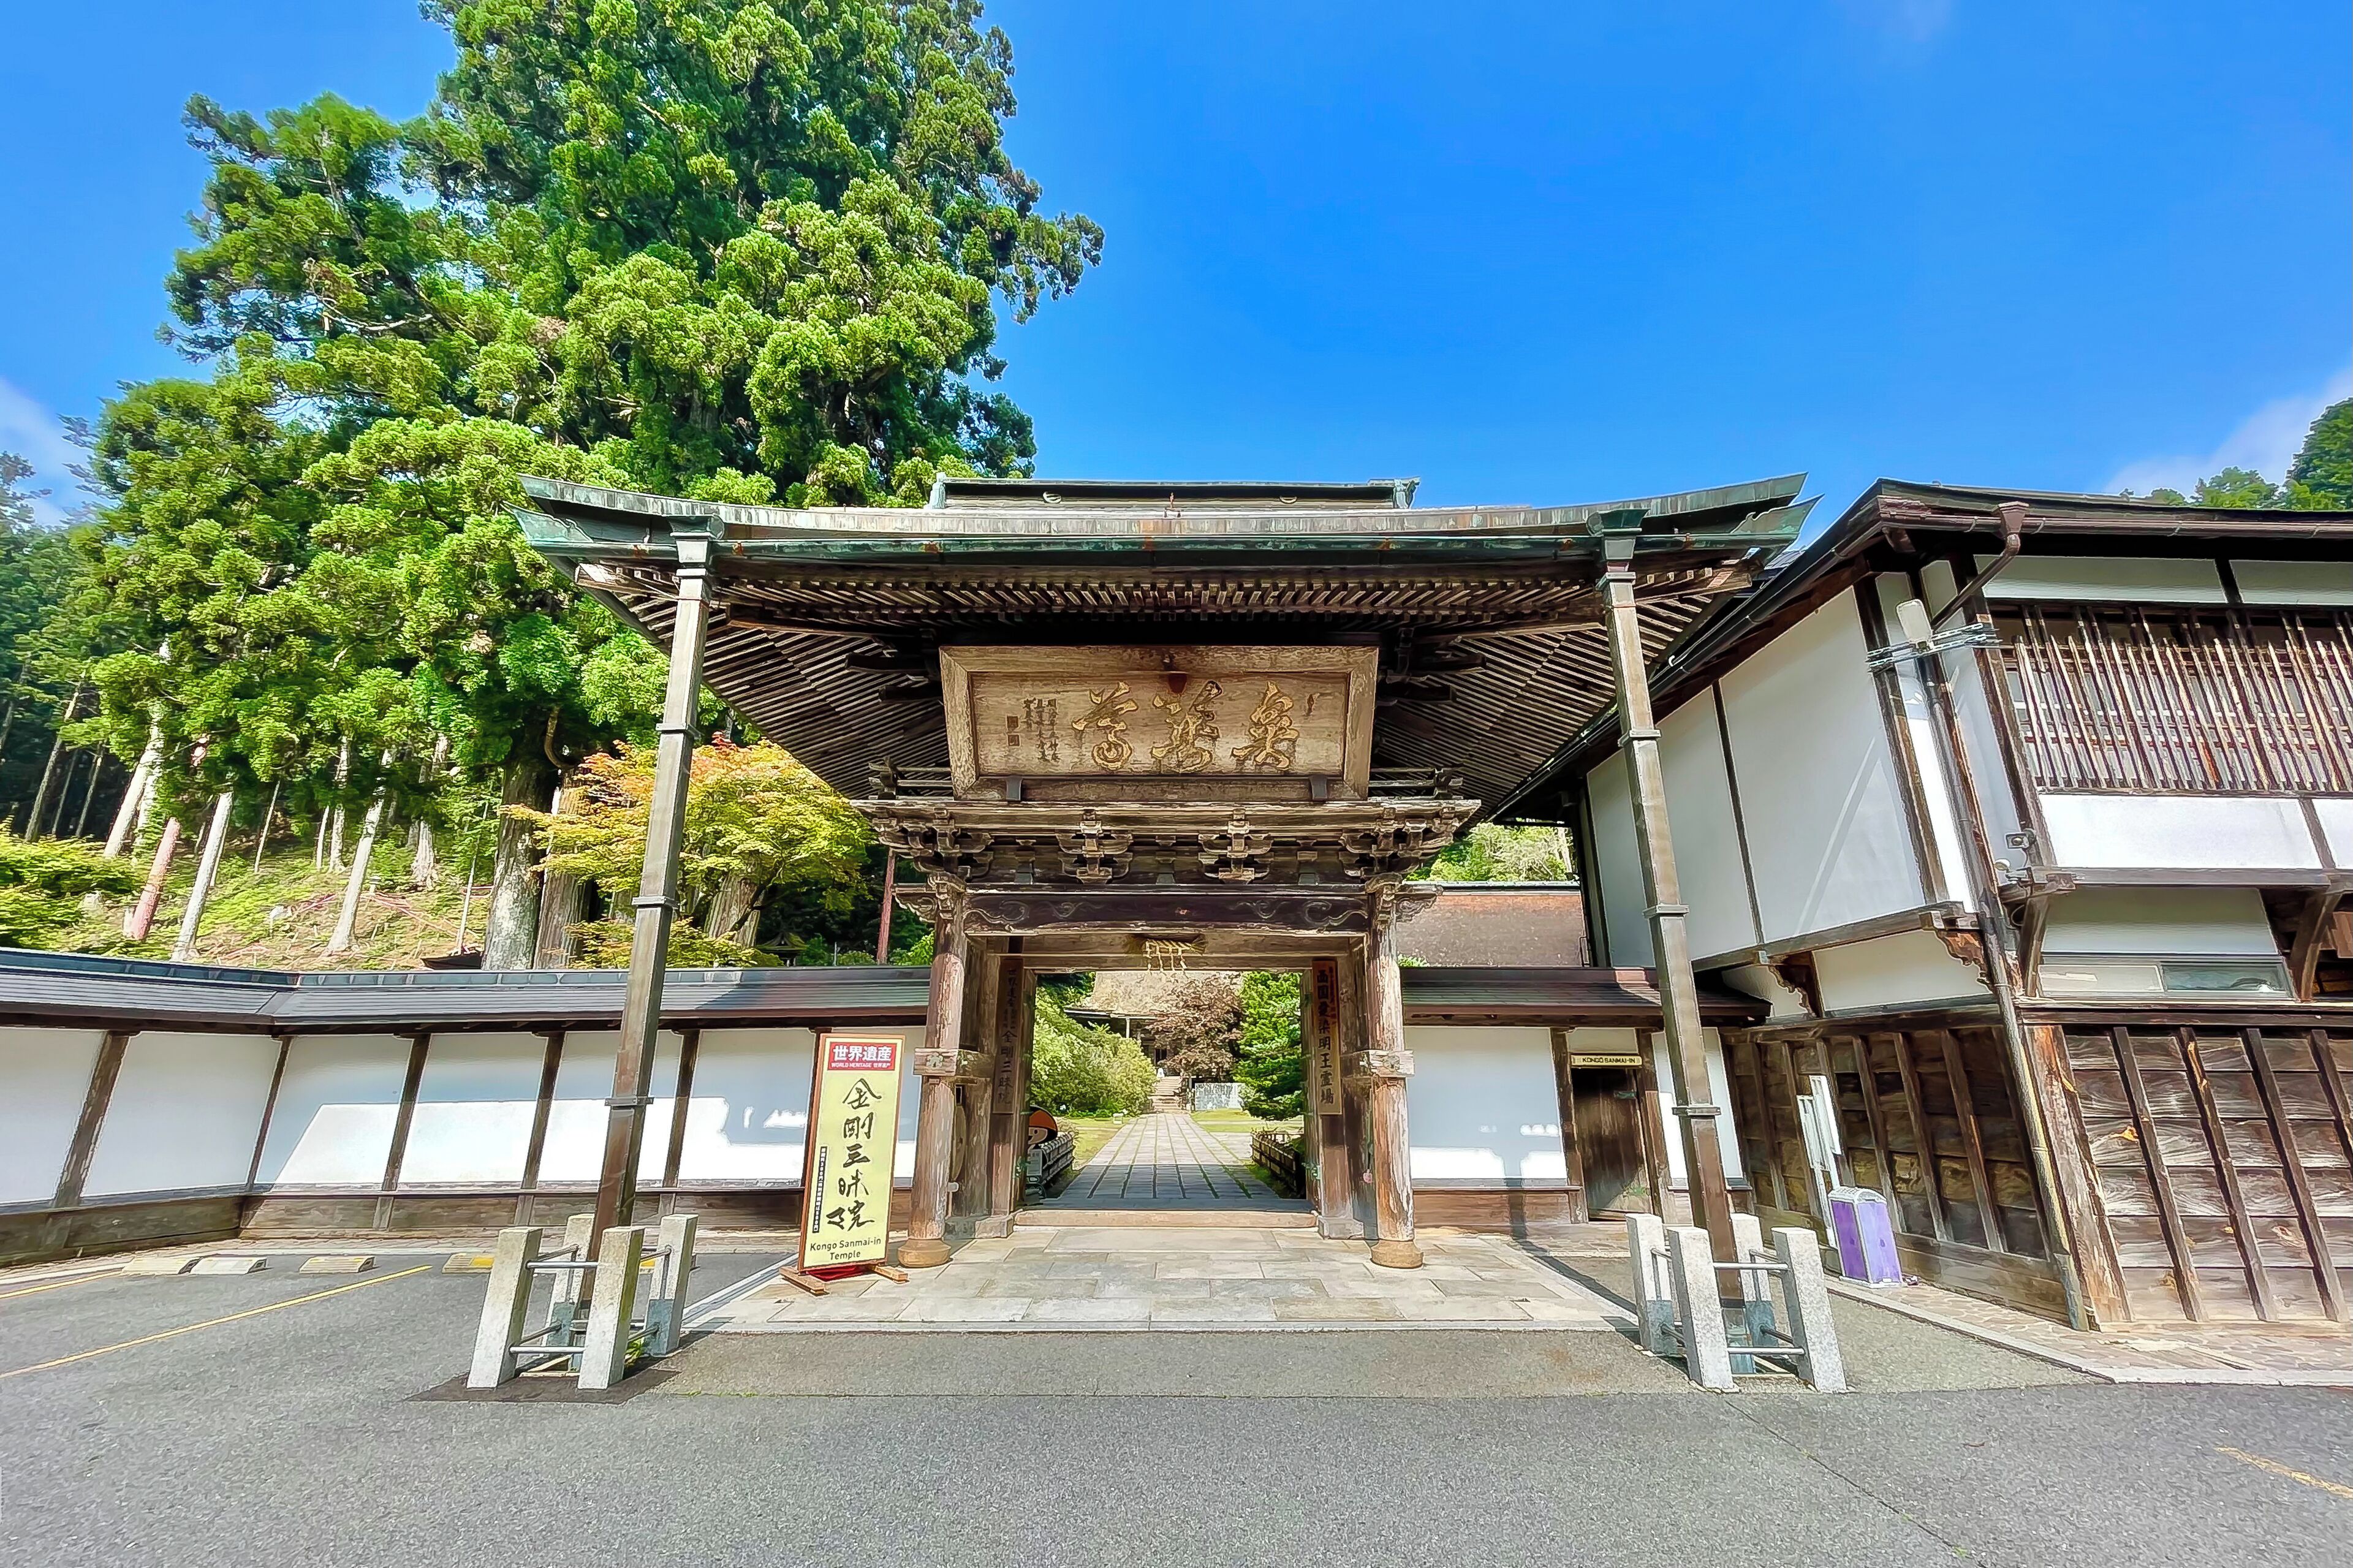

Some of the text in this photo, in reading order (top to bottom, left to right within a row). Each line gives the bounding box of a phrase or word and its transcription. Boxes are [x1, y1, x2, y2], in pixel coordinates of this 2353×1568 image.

[833, 1045, 892, 1061] 世界遺産
[825, 1077, 882, 1232] 金剛三昧院
[809, 1237, 882, 1252] Kongo Sanmai-in
[830, 1250, 861, 1260] Temple
